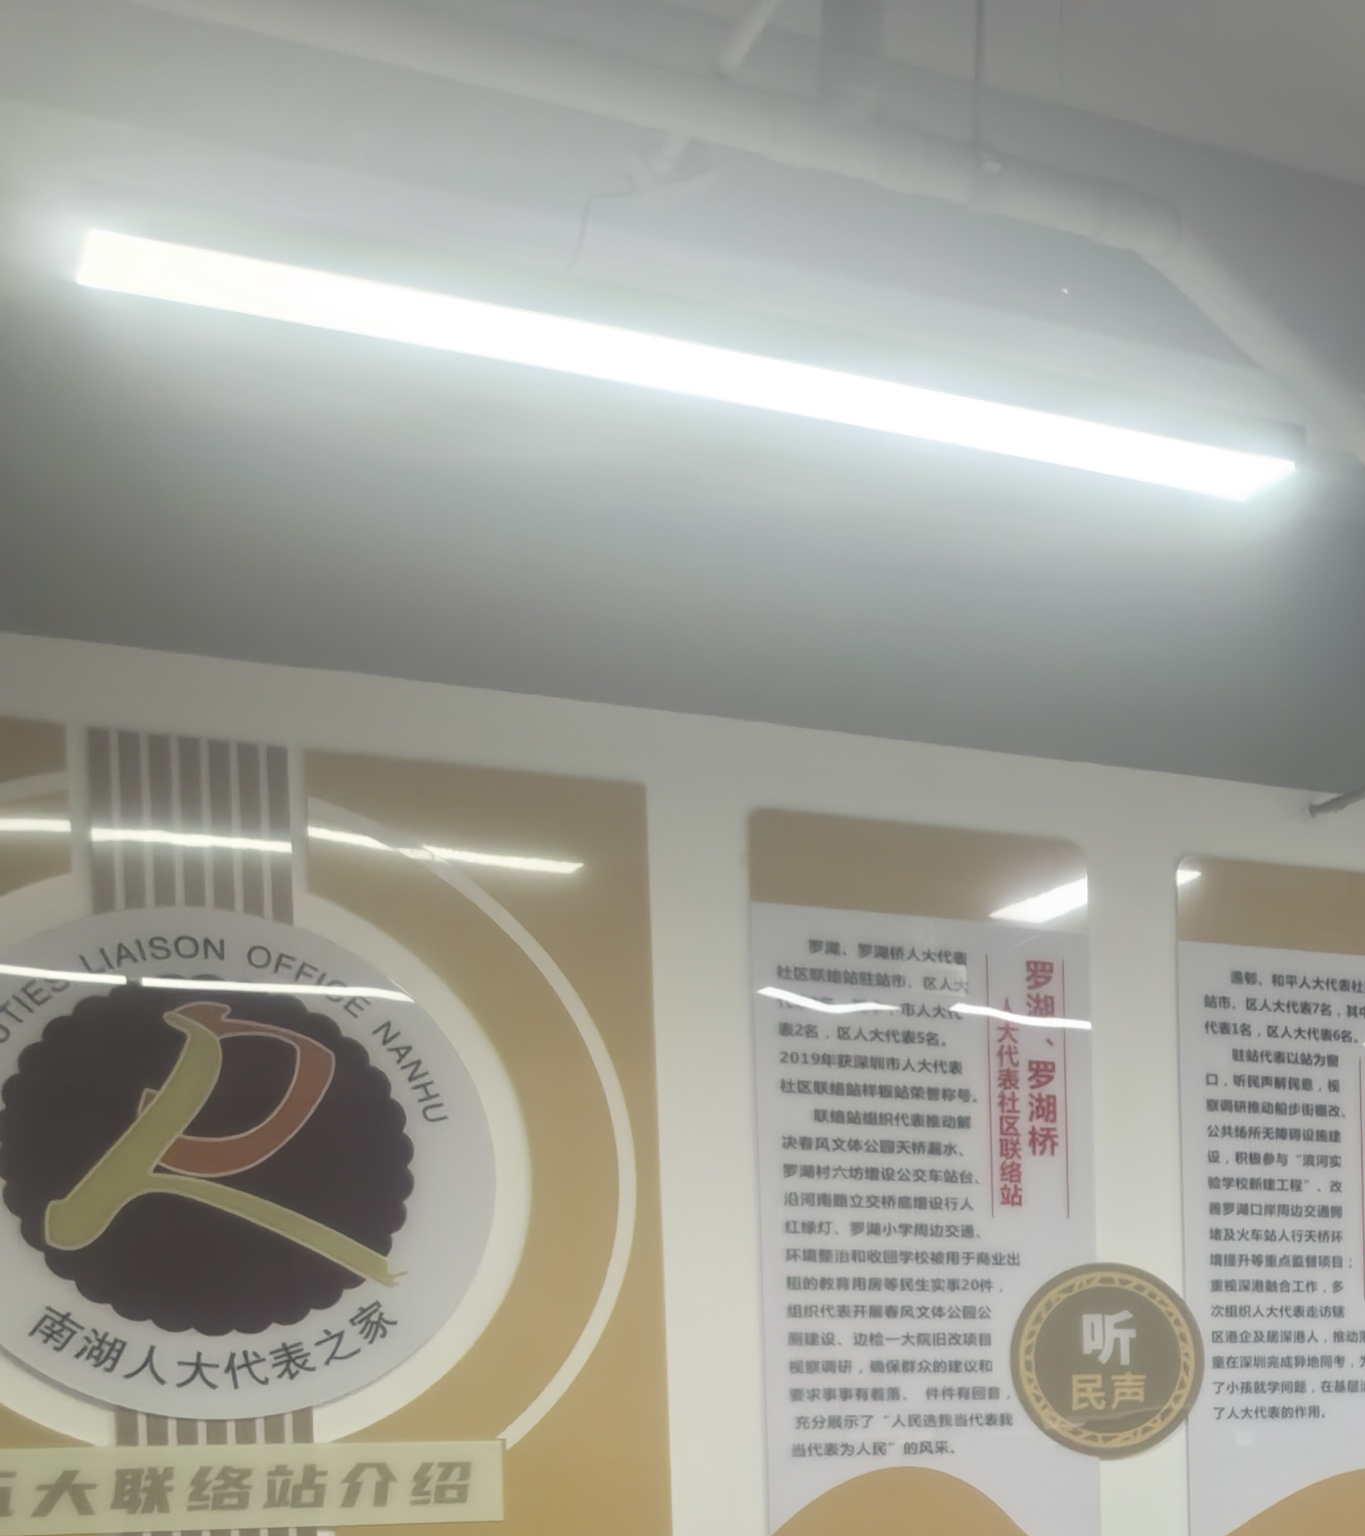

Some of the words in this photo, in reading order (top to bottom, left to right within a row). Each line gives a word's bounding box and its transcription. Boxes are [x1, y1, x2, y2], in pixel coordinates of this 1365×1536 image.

[79, 936, 226, 974] LIAISON
[372, 1020, 449, 1125] NANHU
[996, 997, 1023, 1208] 人大代表社区联络站
[28, 1299, 400, 1392] 南湖人大代表之家
[1081, 1308, 1137, 1367] 听
[1070, 1371, 1147, 1412] 民声
